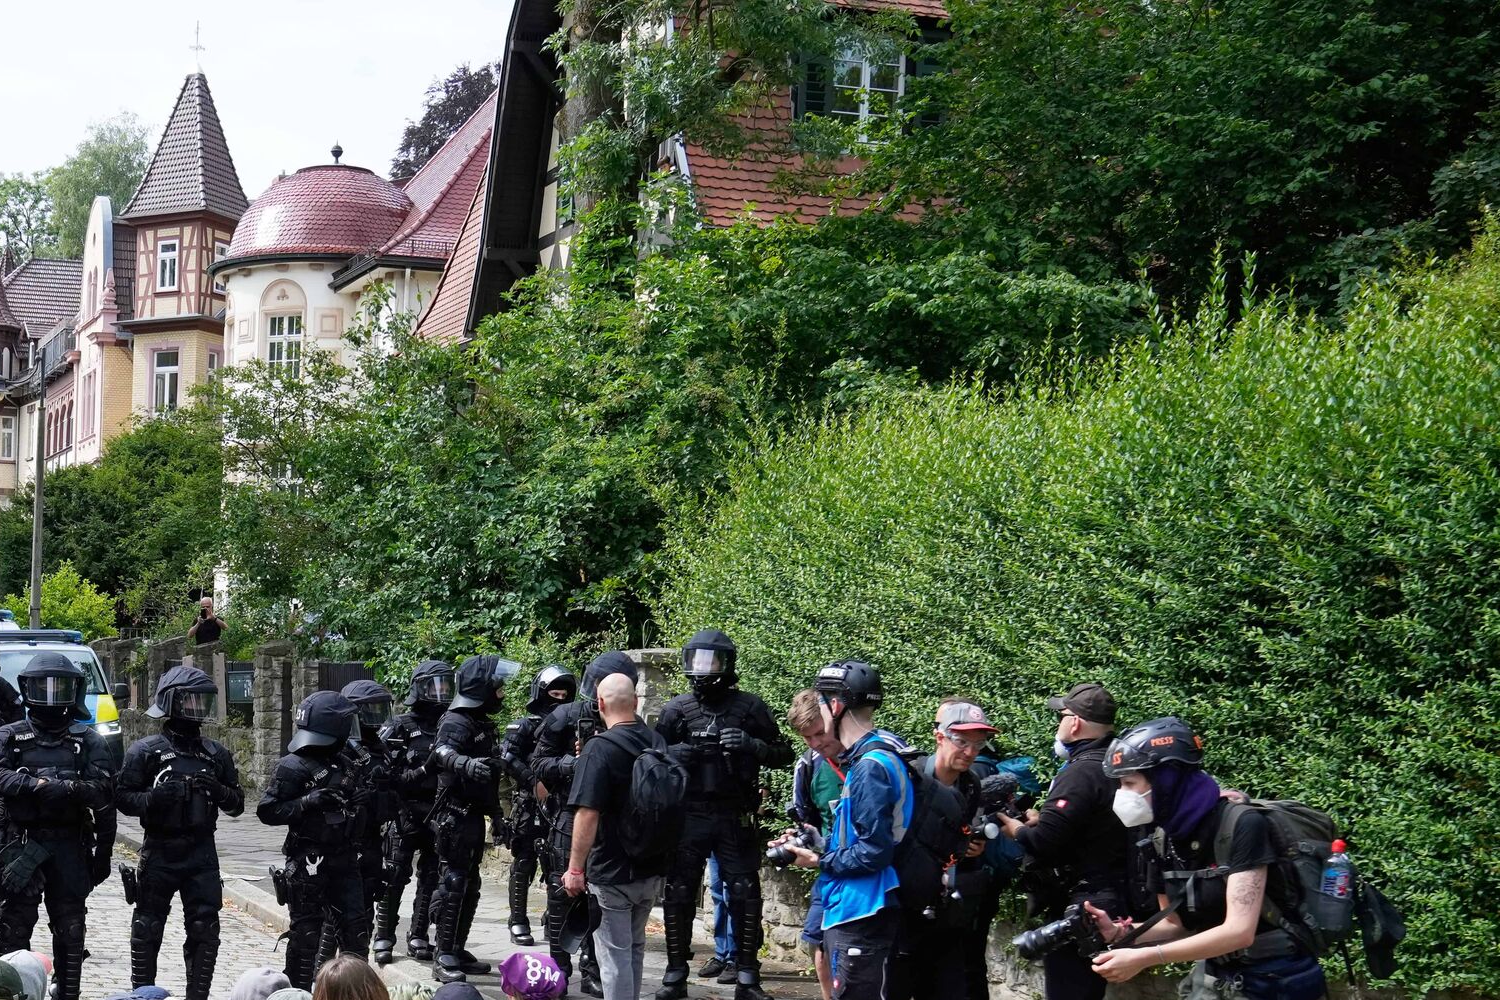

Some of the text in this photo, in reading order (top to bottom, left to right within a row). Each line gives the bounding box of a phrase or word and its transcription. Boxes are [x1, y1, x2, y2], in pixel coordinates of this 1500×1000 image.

[819, 668, 845, 678] PRESS
[15, 733, 35, 741] POLIZEI
[1150, 736, 1174, 746] PRESS
